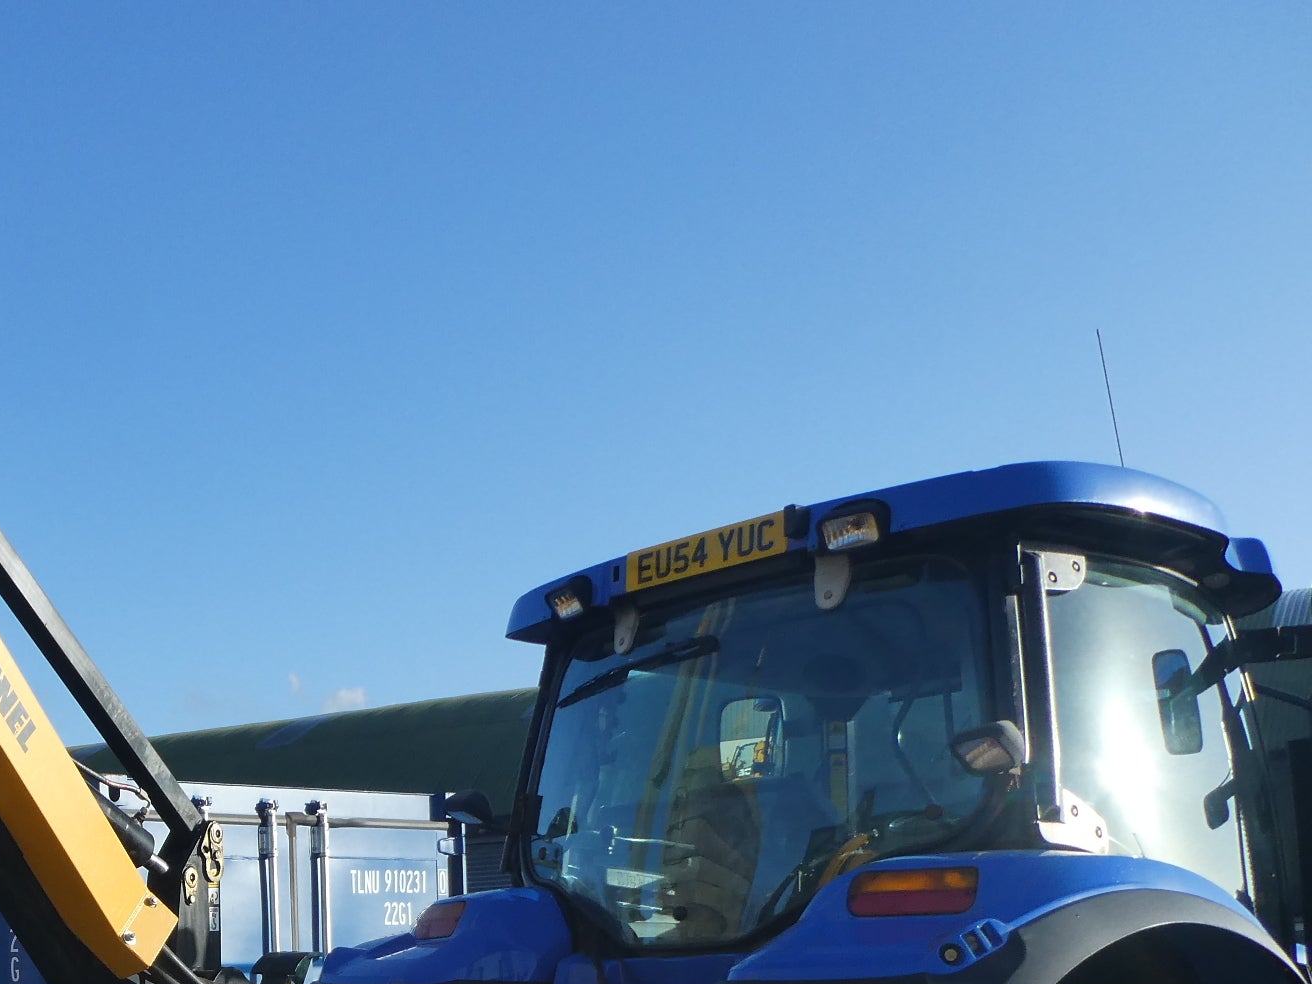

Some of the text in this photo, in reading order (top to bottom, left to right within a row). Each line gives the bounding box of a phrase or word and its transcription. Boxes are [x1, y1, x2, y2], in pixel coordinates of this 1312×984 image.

[637, 519, 775, 584] EU54 YUC
[350, 870, 380, 894] TLNU
[384, 870, 427, 894] 910231
[384, 902, 412, 925] 22G1
